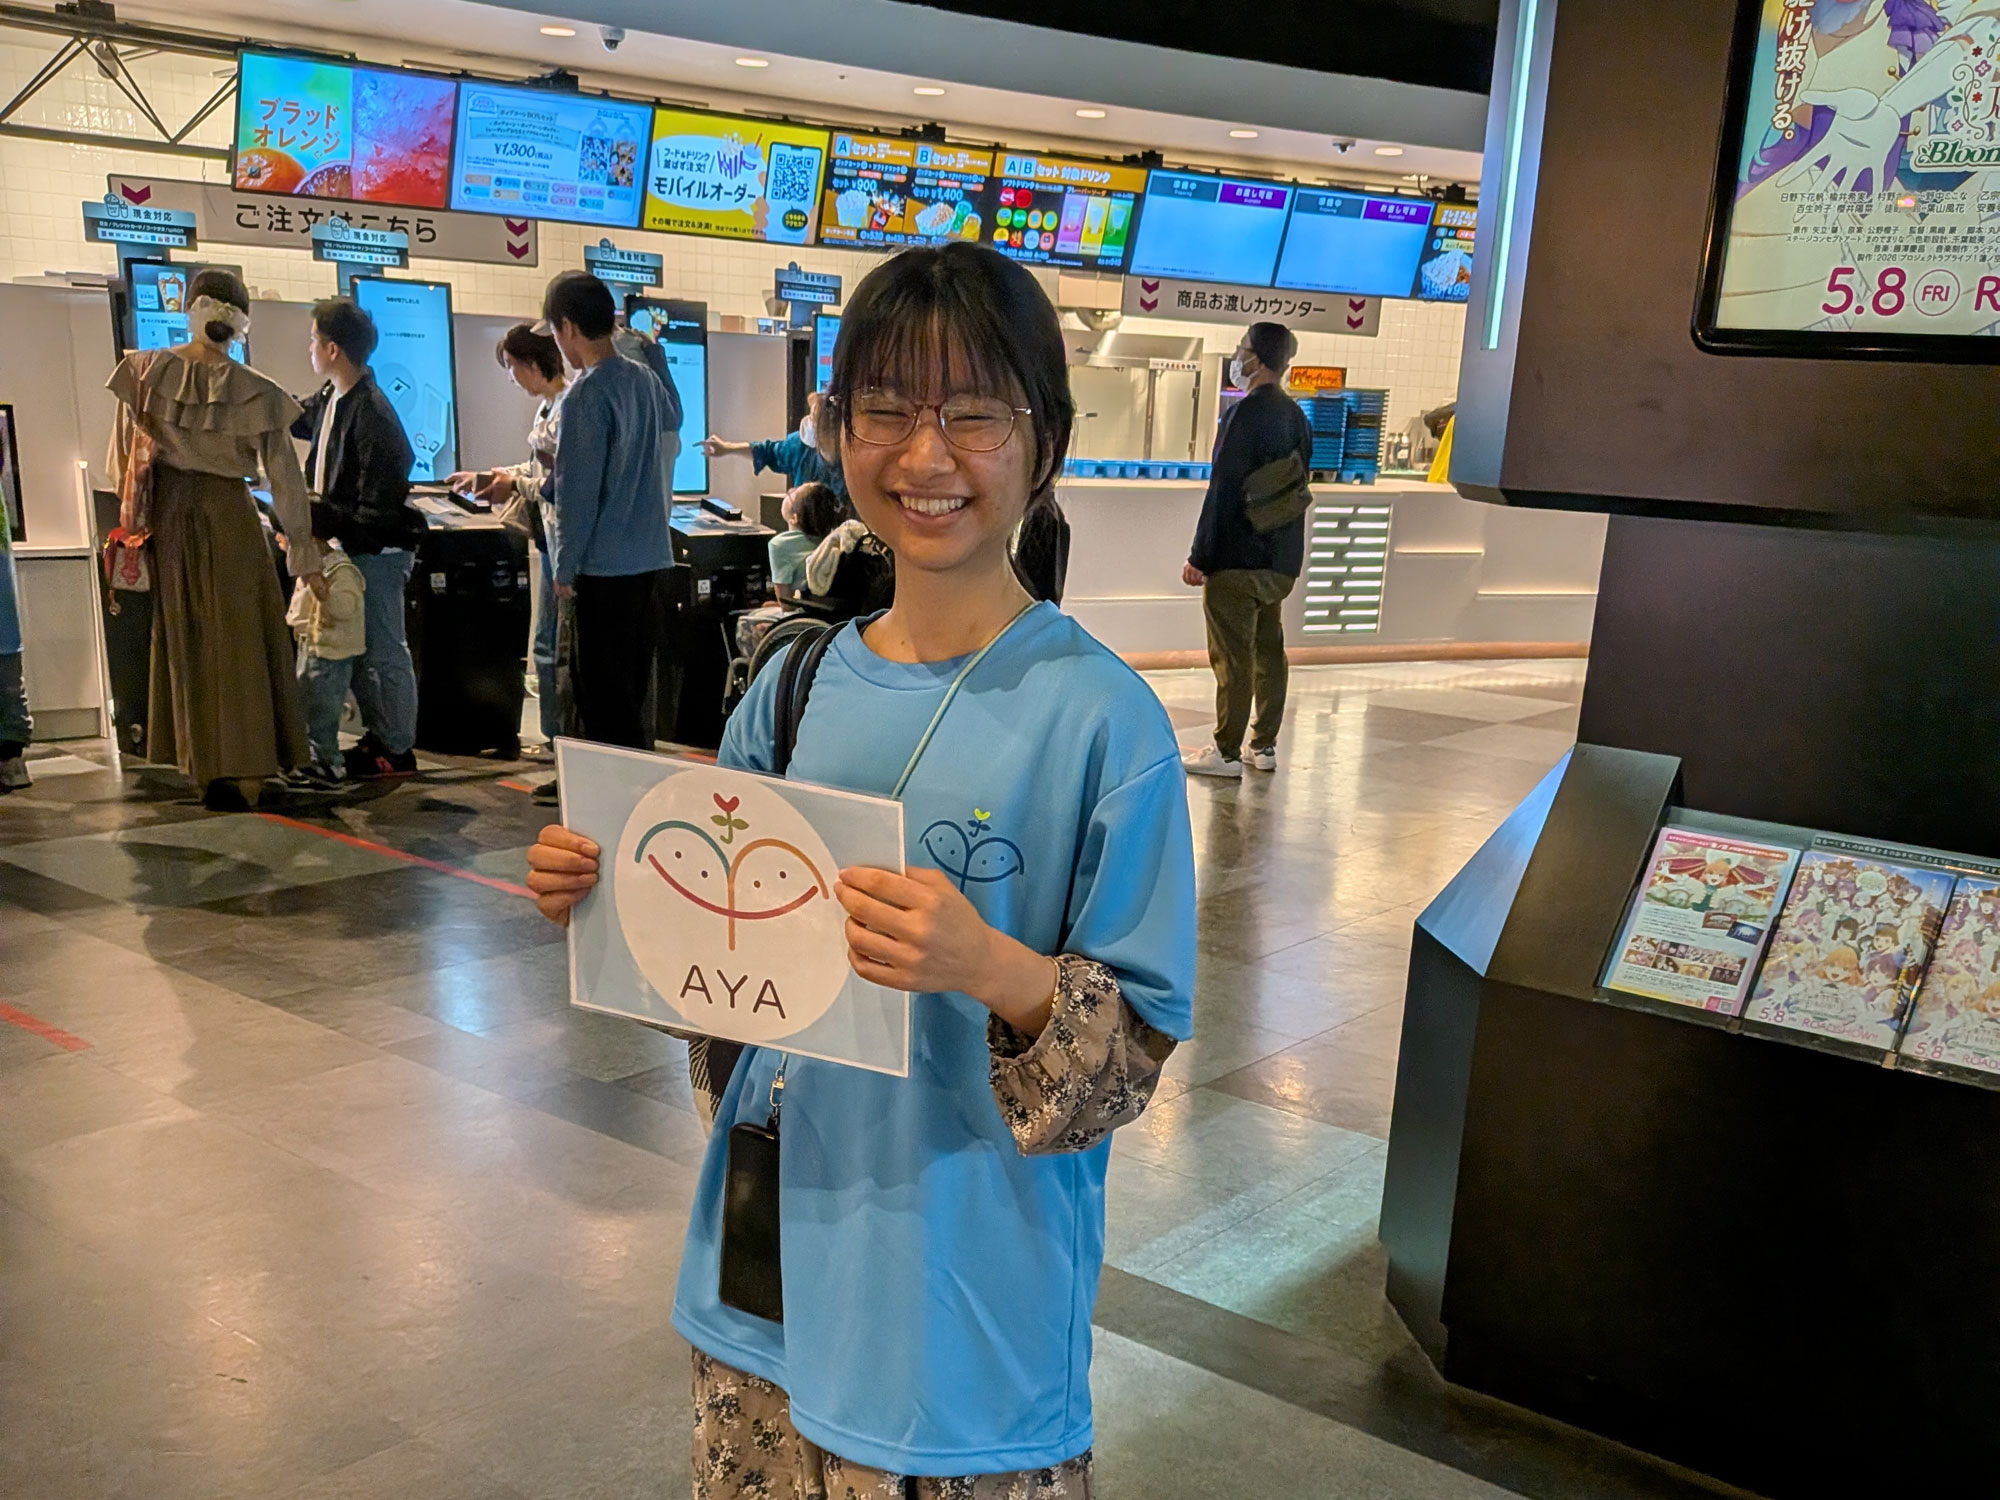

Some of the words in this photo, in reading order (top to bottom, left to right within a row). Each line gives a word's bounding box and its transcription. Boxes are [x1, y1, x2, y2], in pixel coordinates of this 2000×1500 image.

[260, 97, 339, 129] ブラッド
[254, 124, 340, 154] オレンジ
[838, 140, 847, 153] A
[852, 143, 875, 157] セット
[919, 150, 929, 162] B
[932, 152, 955, 166] セット
[1008, 160, 1017, 172] A
[1024, 162, 1033, 174] B
[1037, 165, 1059, 178] セット
[654, 176, 756, 203] モバイルオーダー
[851, 178, 878, 192] ¥900
[931, 187, 964, 201] ¥1,400
[133, 208, 172, 222] 現金対応
[354, 231, 387, 243] 現金対応
[1447, 284, 1470, 296] ¥95
[1822, 267, 1906, 316] 5.8
[1922, 285, 1949, 301] FRI
[1177, 288, 1326, 317] 商品お渡しカウンター
[680, 965, 786, 1019] AYA
[1759, 1007, 1785, 1024] 5.8
[1914, 1042, 1944, 1060] 5.8
[1963, 1055, 2000, 1070] ROAD
